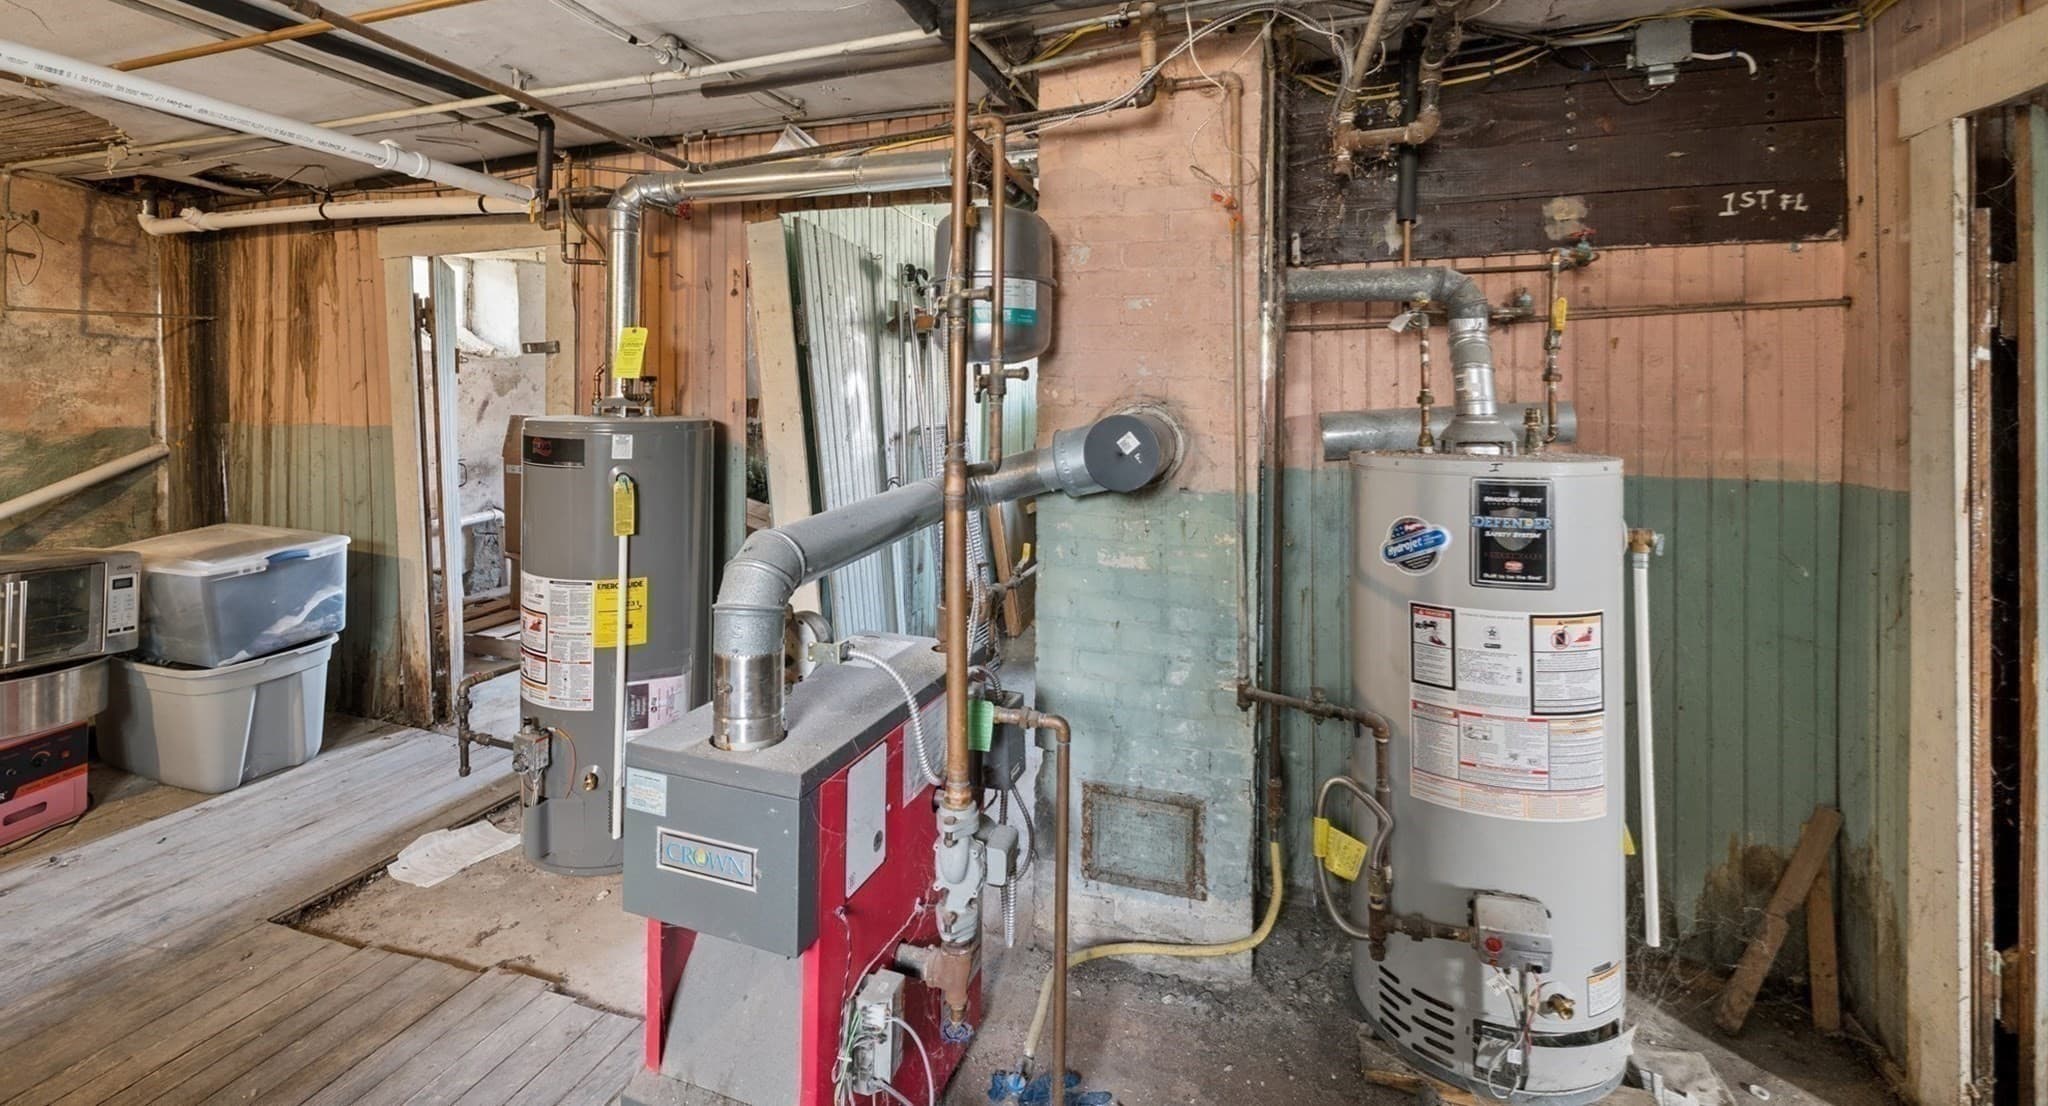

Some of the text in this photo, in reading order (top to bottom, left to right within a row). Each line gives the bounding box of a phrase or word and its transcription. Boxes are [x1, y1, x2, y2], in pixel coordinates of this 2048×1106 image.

[1718, 188, 1809, 217] 1ST FL
[1472, 515, 1553, 530] DEFENDER
[665, 841, 746, 879] CROWN
